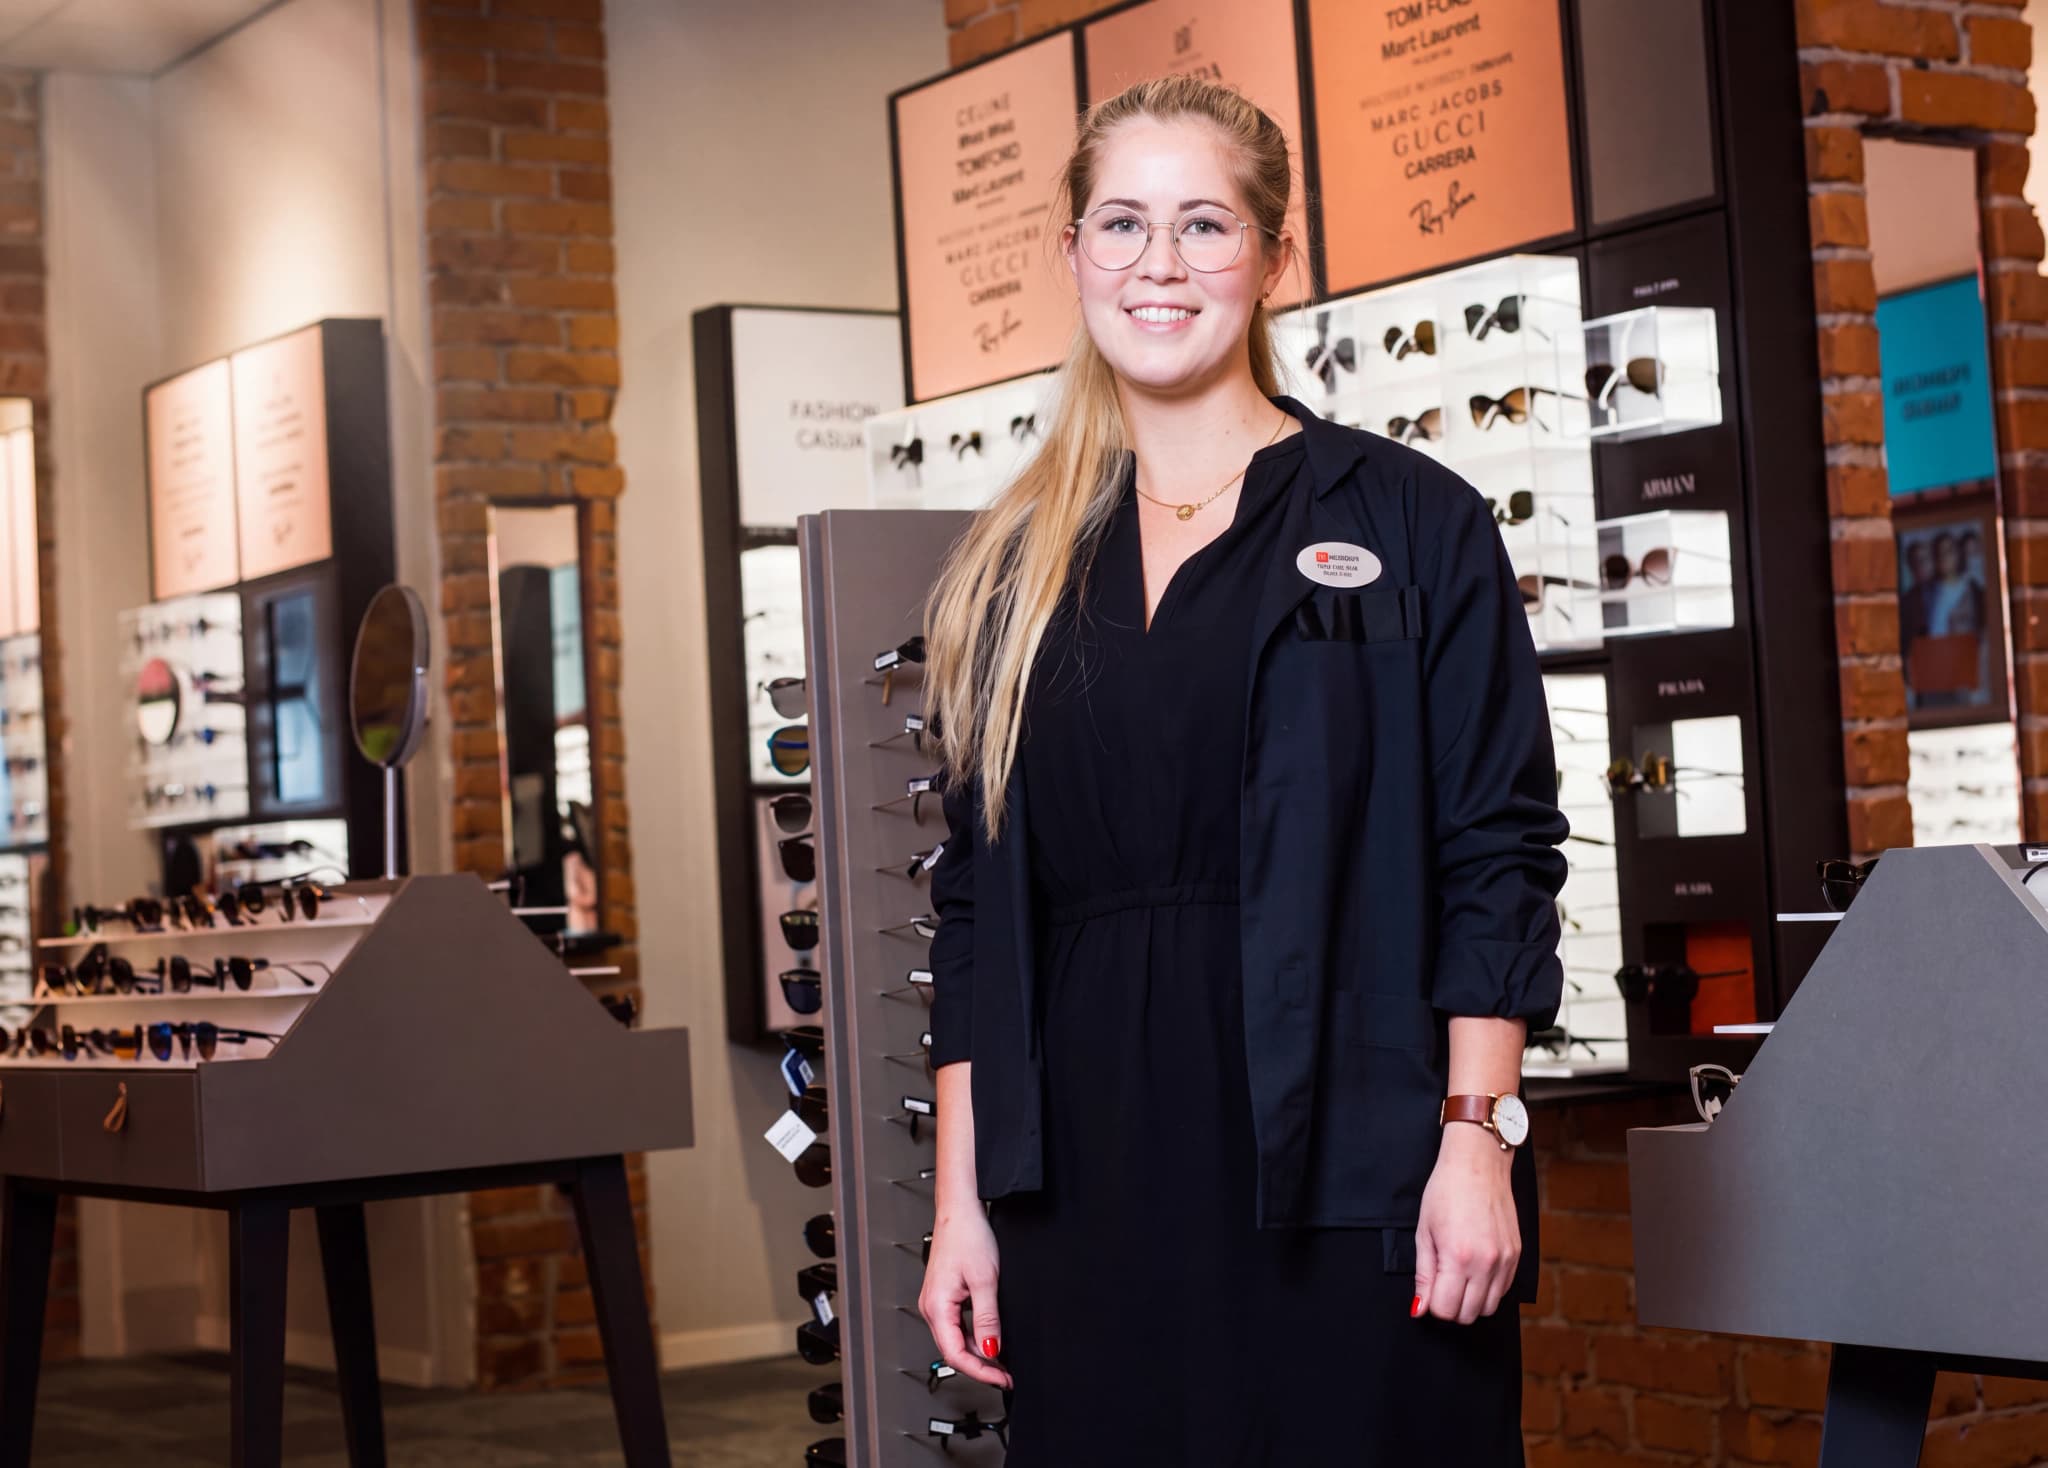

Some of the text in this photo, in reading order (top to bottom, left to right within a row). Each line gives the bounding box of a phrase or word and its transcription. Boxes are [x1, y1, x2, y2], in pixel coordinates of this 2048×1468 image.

[1386, 1, 1423, 30] TOM
[1419, 12, 1480, 49] Laurent
[1371, 104, 1420, 132] MARC
[1430, 79, 1503, 116] JACOBS
[1392, 109, 1485, 157] GUCCI
[1405, 144, 1476, 179] CARRERA
[794, 428, 864, 450] CASUA
[1641, 473, 1695, 501] ARMANI
[1658, 678, 1705, 697] PRADA
